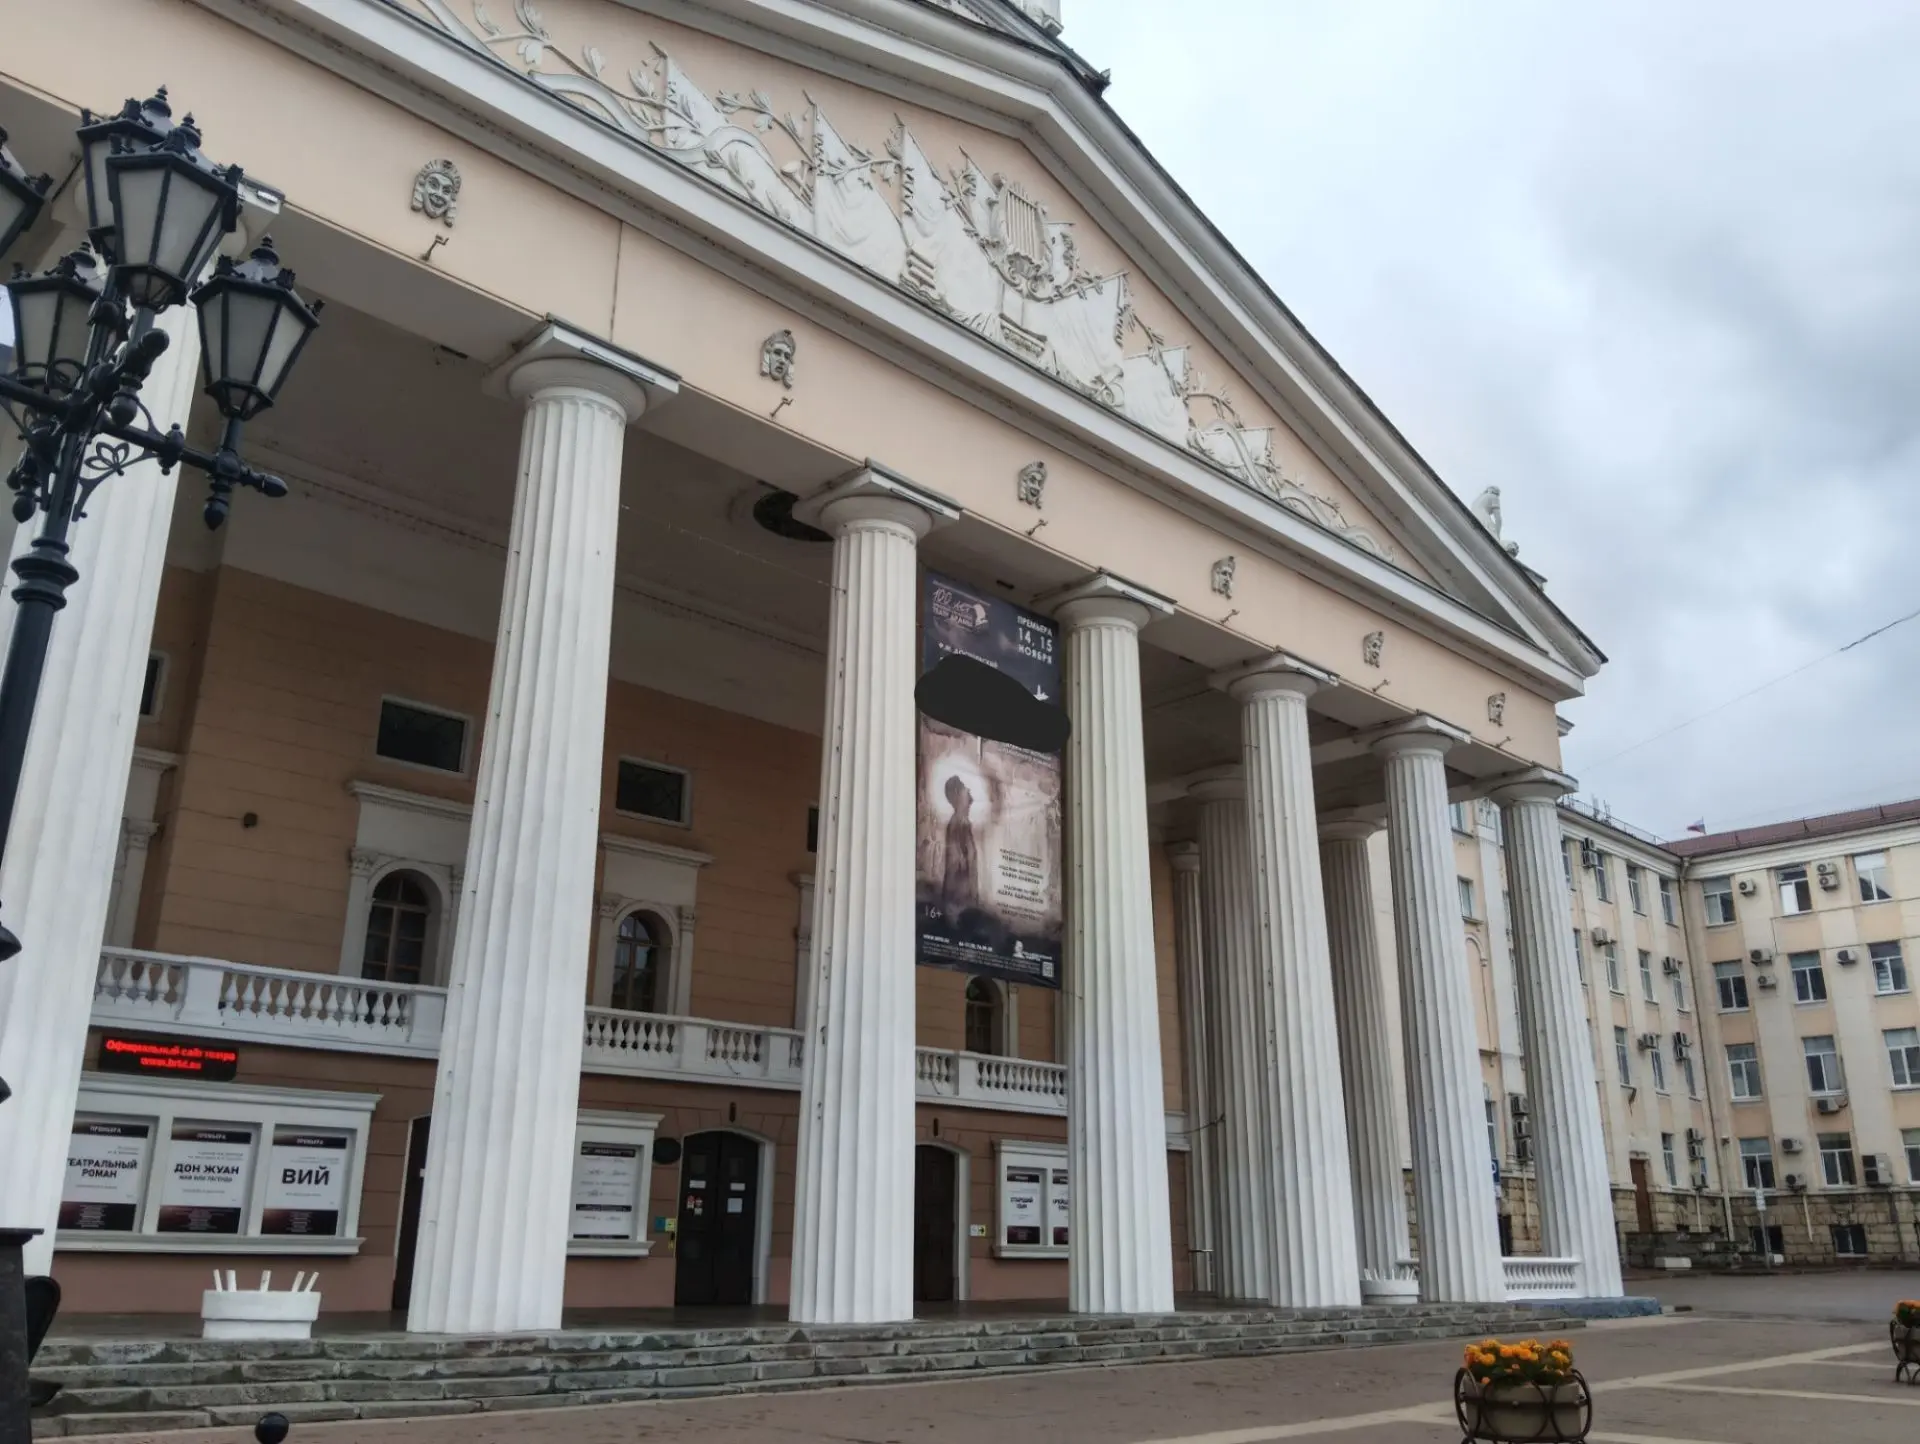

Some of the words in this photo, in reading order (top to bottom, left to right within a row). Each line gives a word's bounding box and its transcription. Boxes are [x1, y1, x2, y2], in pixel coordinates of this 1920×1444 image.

[1017, 615, 1052, 637] ПРЕМЬЕРА
[1040, 635, 1052, 652] 15
[1018, 644, 1052, 665] НОЯБРЯ
[925, 904, 942, 919] 16+
[81, 1168, 118, 1179] РОМАН
[173, 1162, 201, 1174] ДОН
[203, 1164, 240, 1175] ЖУАН
[282, 1165, 330, 1186] ВИЙ
